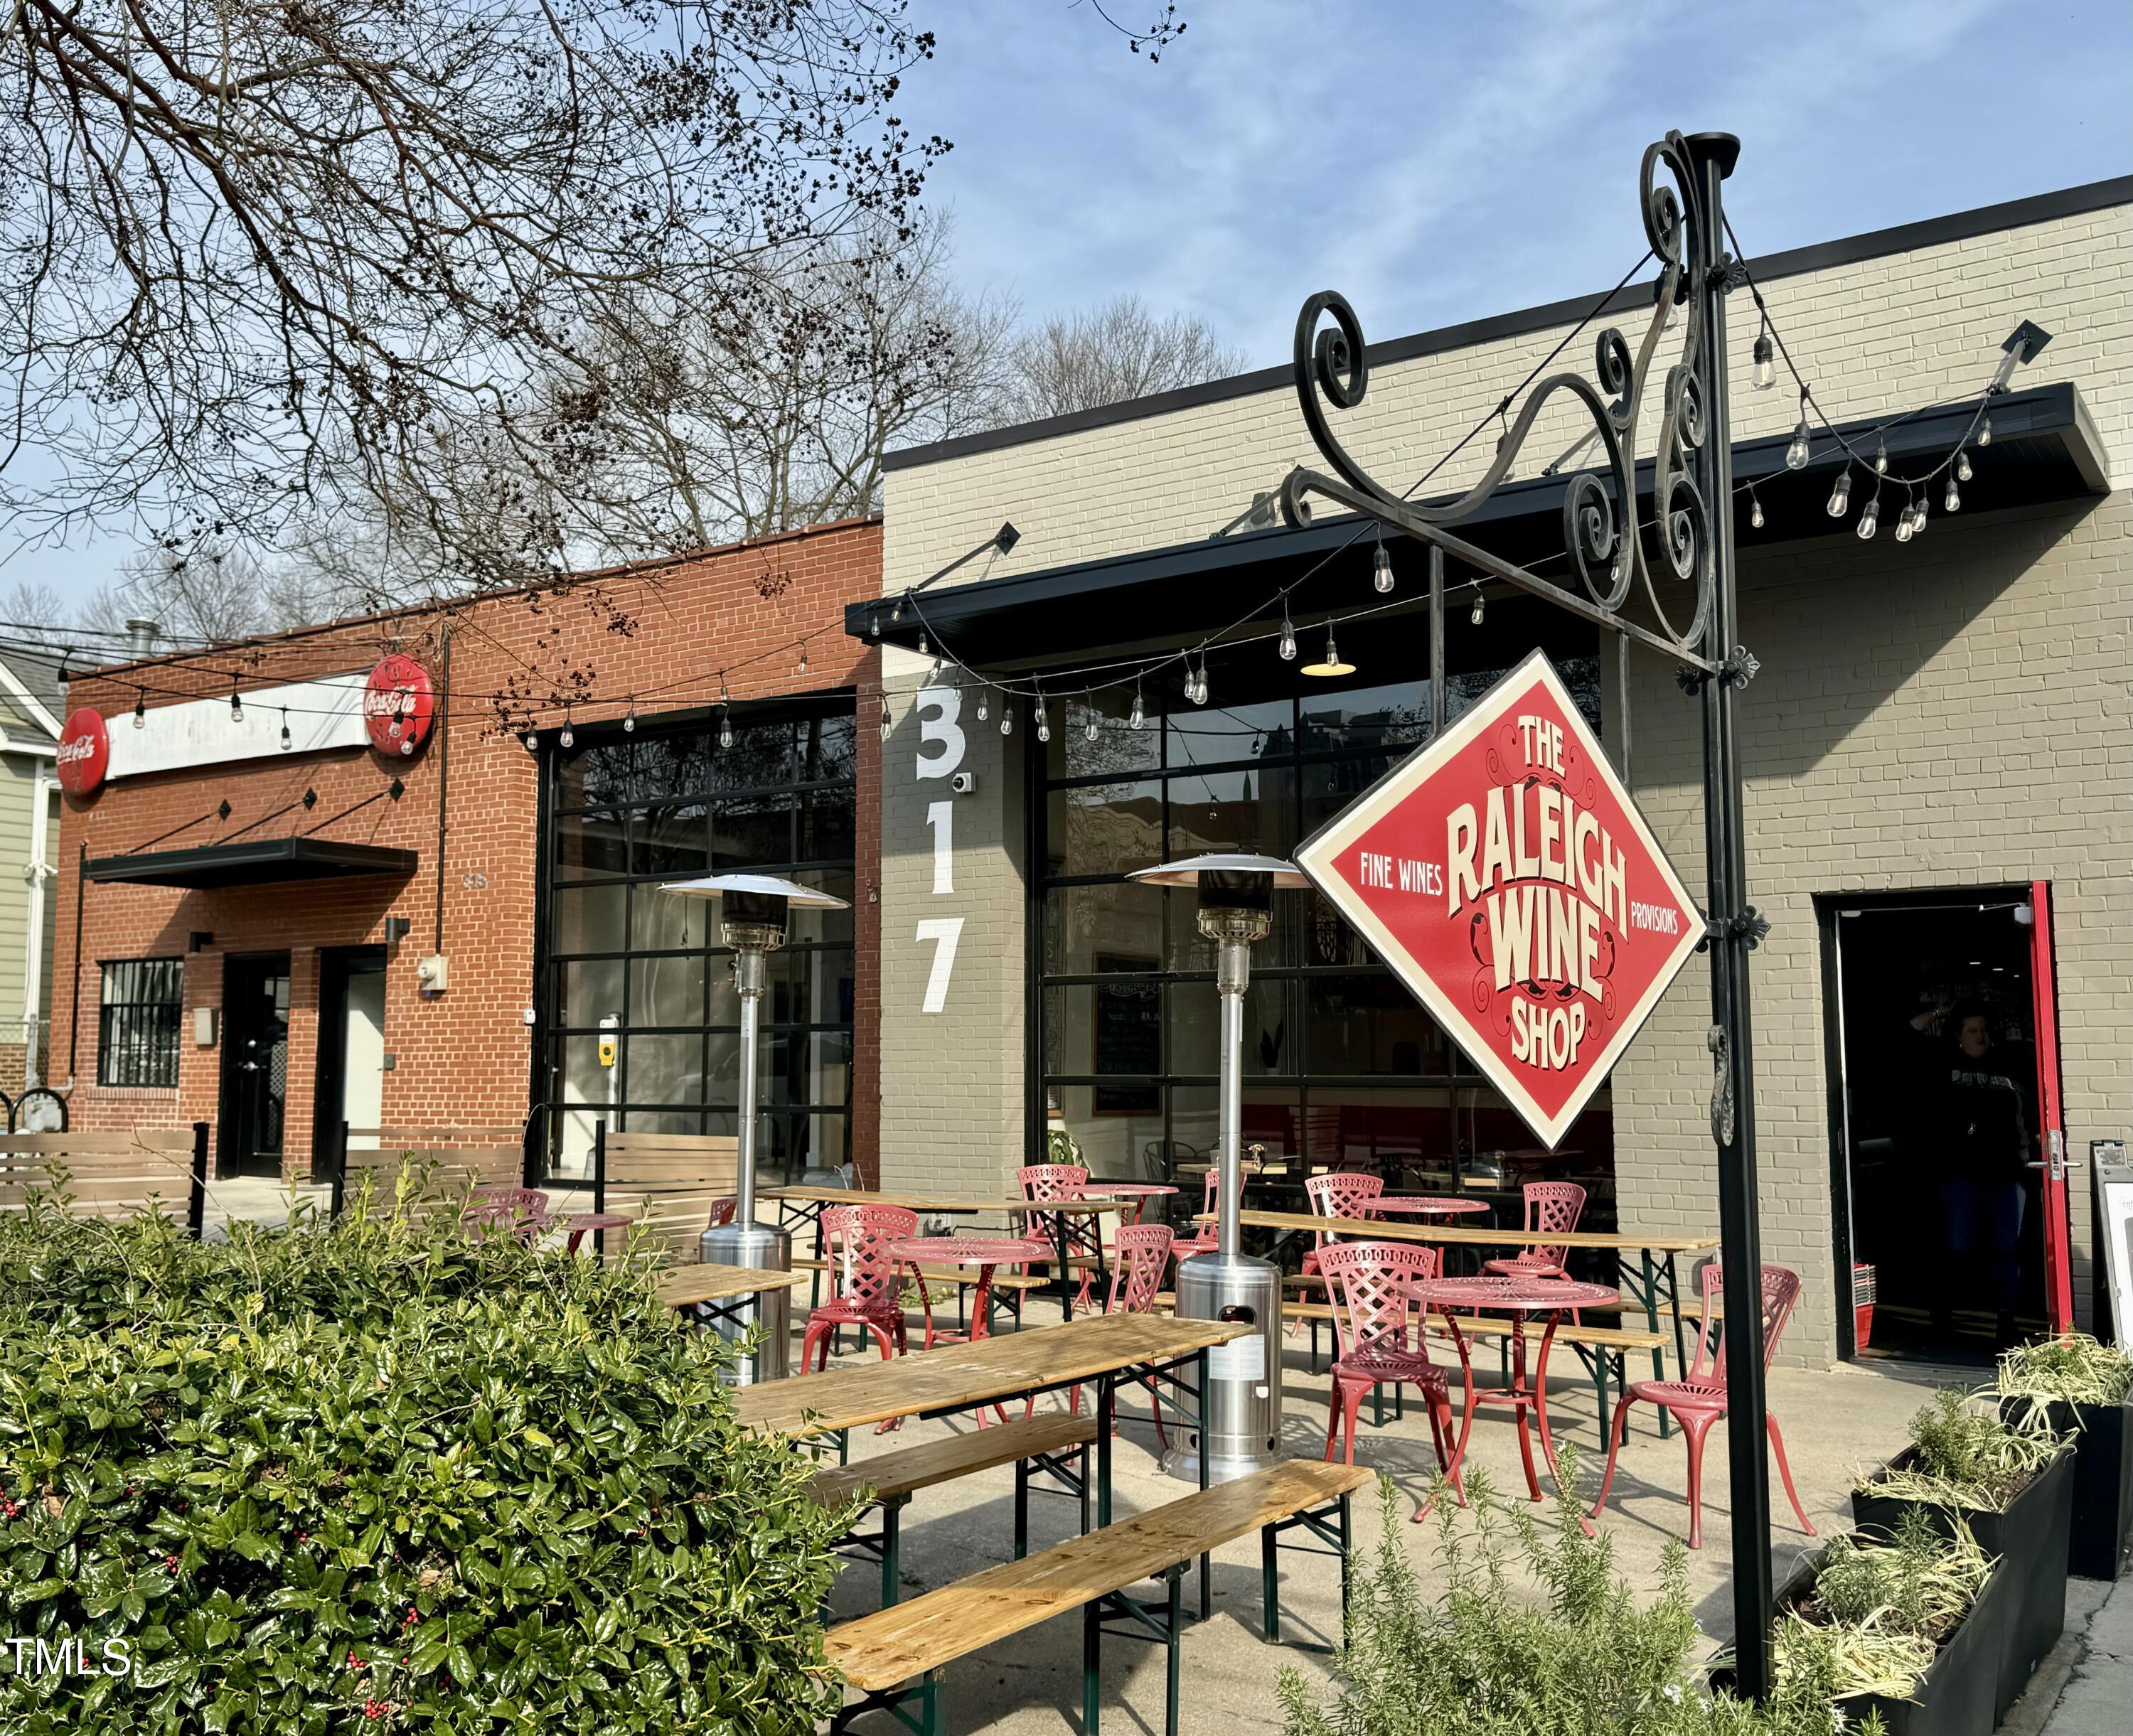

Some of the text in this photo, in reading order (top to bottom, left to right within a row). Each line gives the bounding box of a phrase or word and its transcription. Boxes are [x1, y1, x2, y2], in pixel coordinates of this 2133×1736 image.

[365, 685, 418, 719] Coca-Cola
[1519, 716, 1564, 774] THE
[916, 685, 966, 1012] 317
[1361, 852, 1443, 896] FINE WINES
[1447, 783, 1628, 942] RALEIGH
[1487, 886, 1603, 1001] WINE
[1631, 901, 1678, 935] PROVISIONS
[1512, 996, 1586, 1069] SHOP
